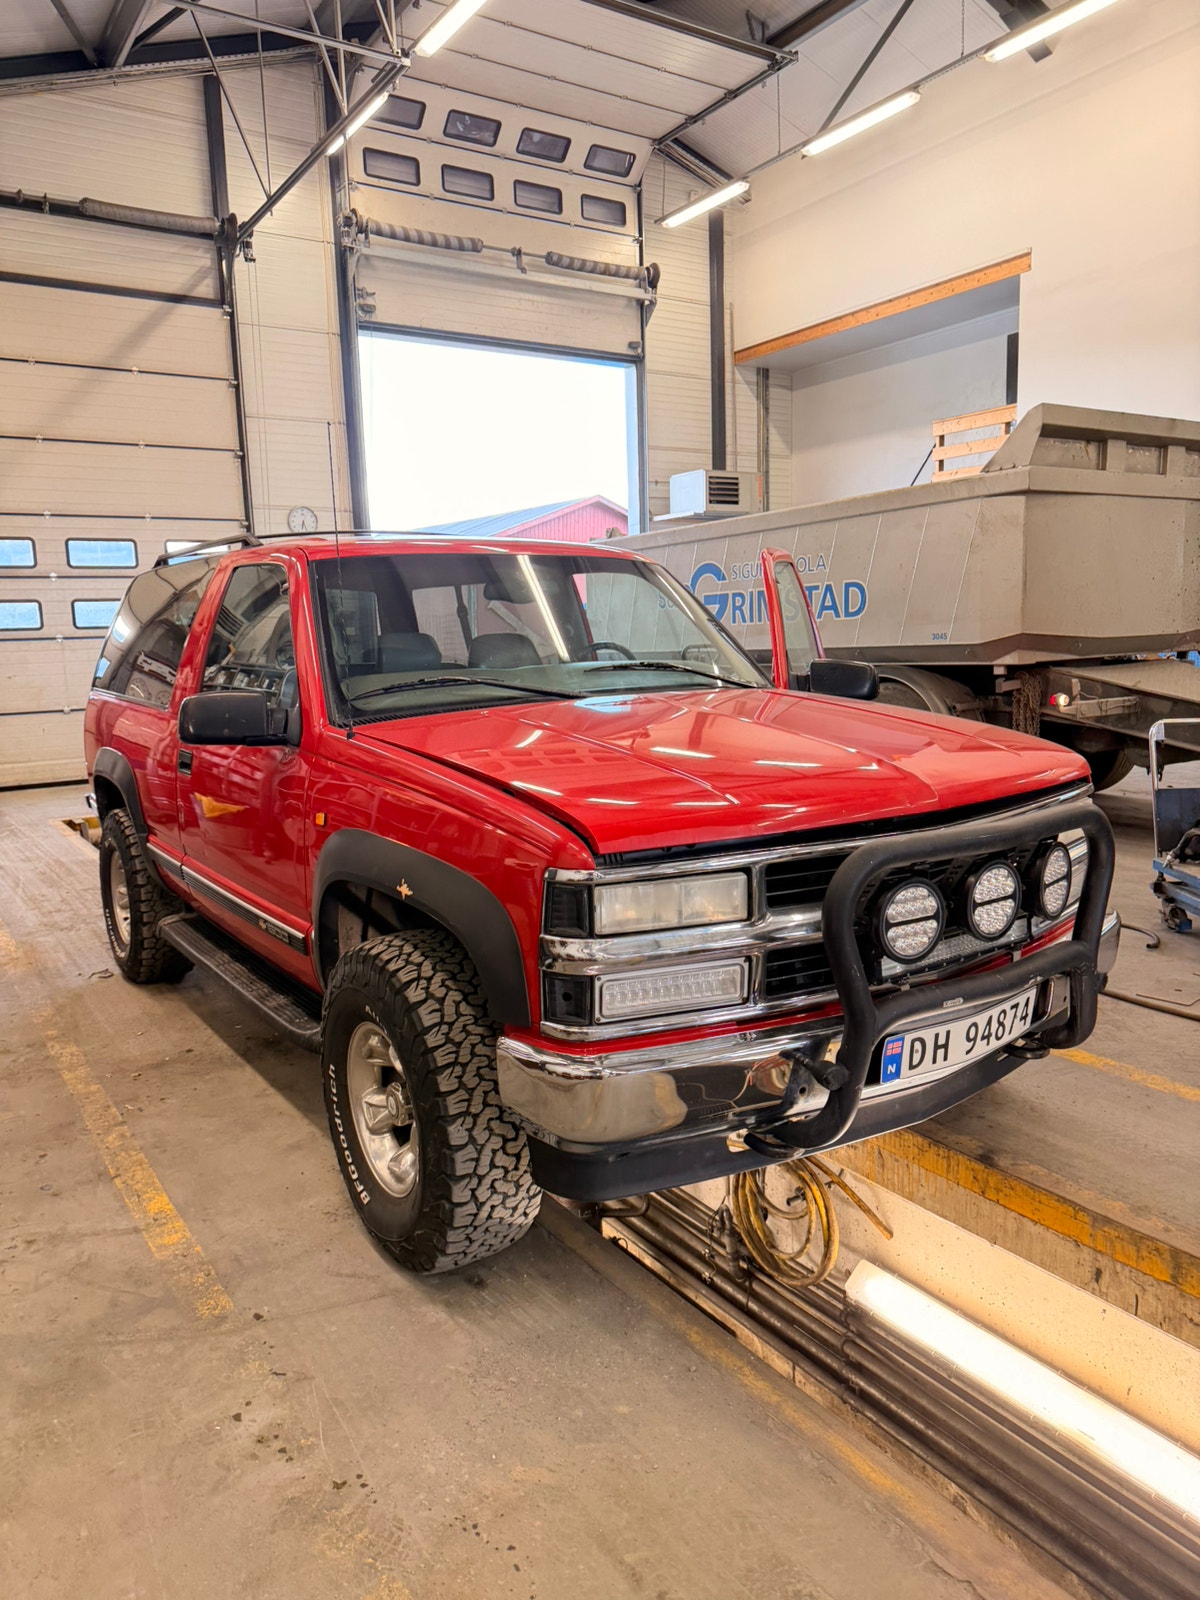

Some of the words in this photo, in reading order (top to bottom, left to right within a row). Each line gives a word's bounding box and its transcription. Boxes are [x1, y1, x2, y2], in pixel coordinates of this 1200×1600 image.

[796, 554, 827, 574] OLA
[908, 1029, 950, 1071] DH
[965, 996, 1031, 1056] 94874
[887, 1063, 896, 1074] N
[328, 1063, 371, 1205] BFGoodrich
